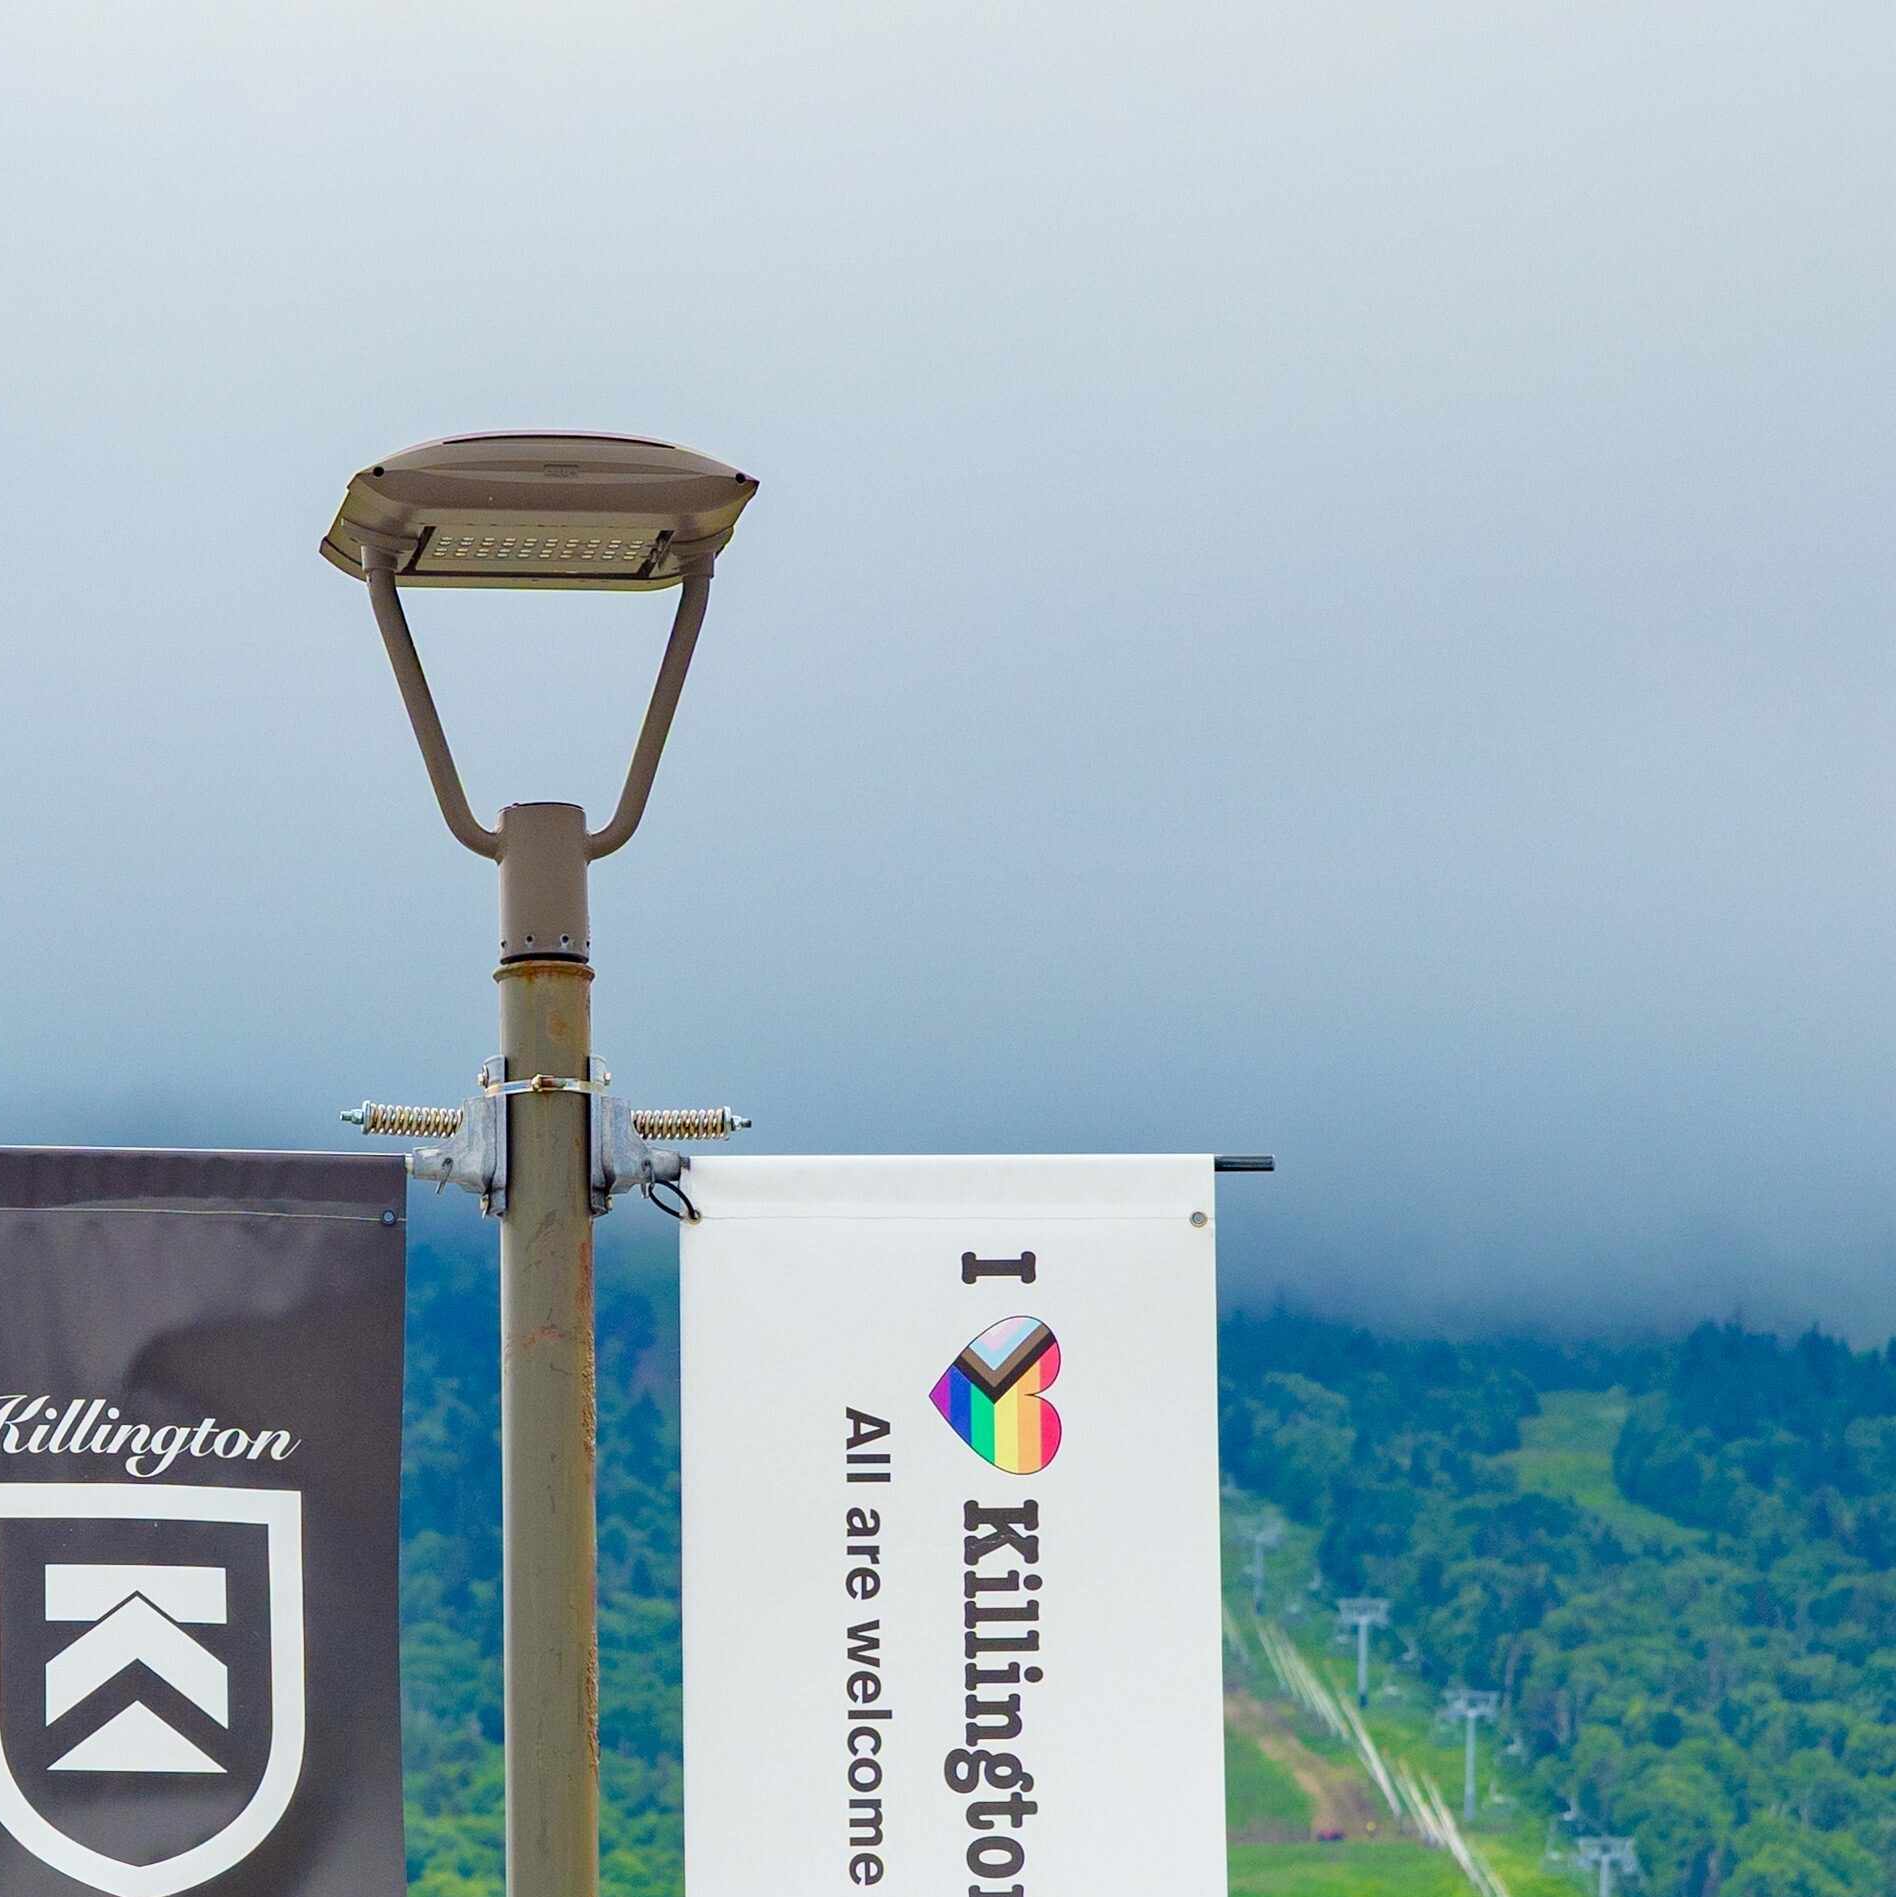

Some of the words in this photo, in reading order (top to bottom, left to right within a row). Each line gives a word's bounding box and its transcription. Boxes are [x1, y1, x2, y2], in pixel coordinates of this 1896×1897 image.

[961, 1251, 1037, 1285] I
[845, 1406, 891, 1483] All
[845, 1507, 881, 1600] are
[846, 1619, 893, 1886] welcome
